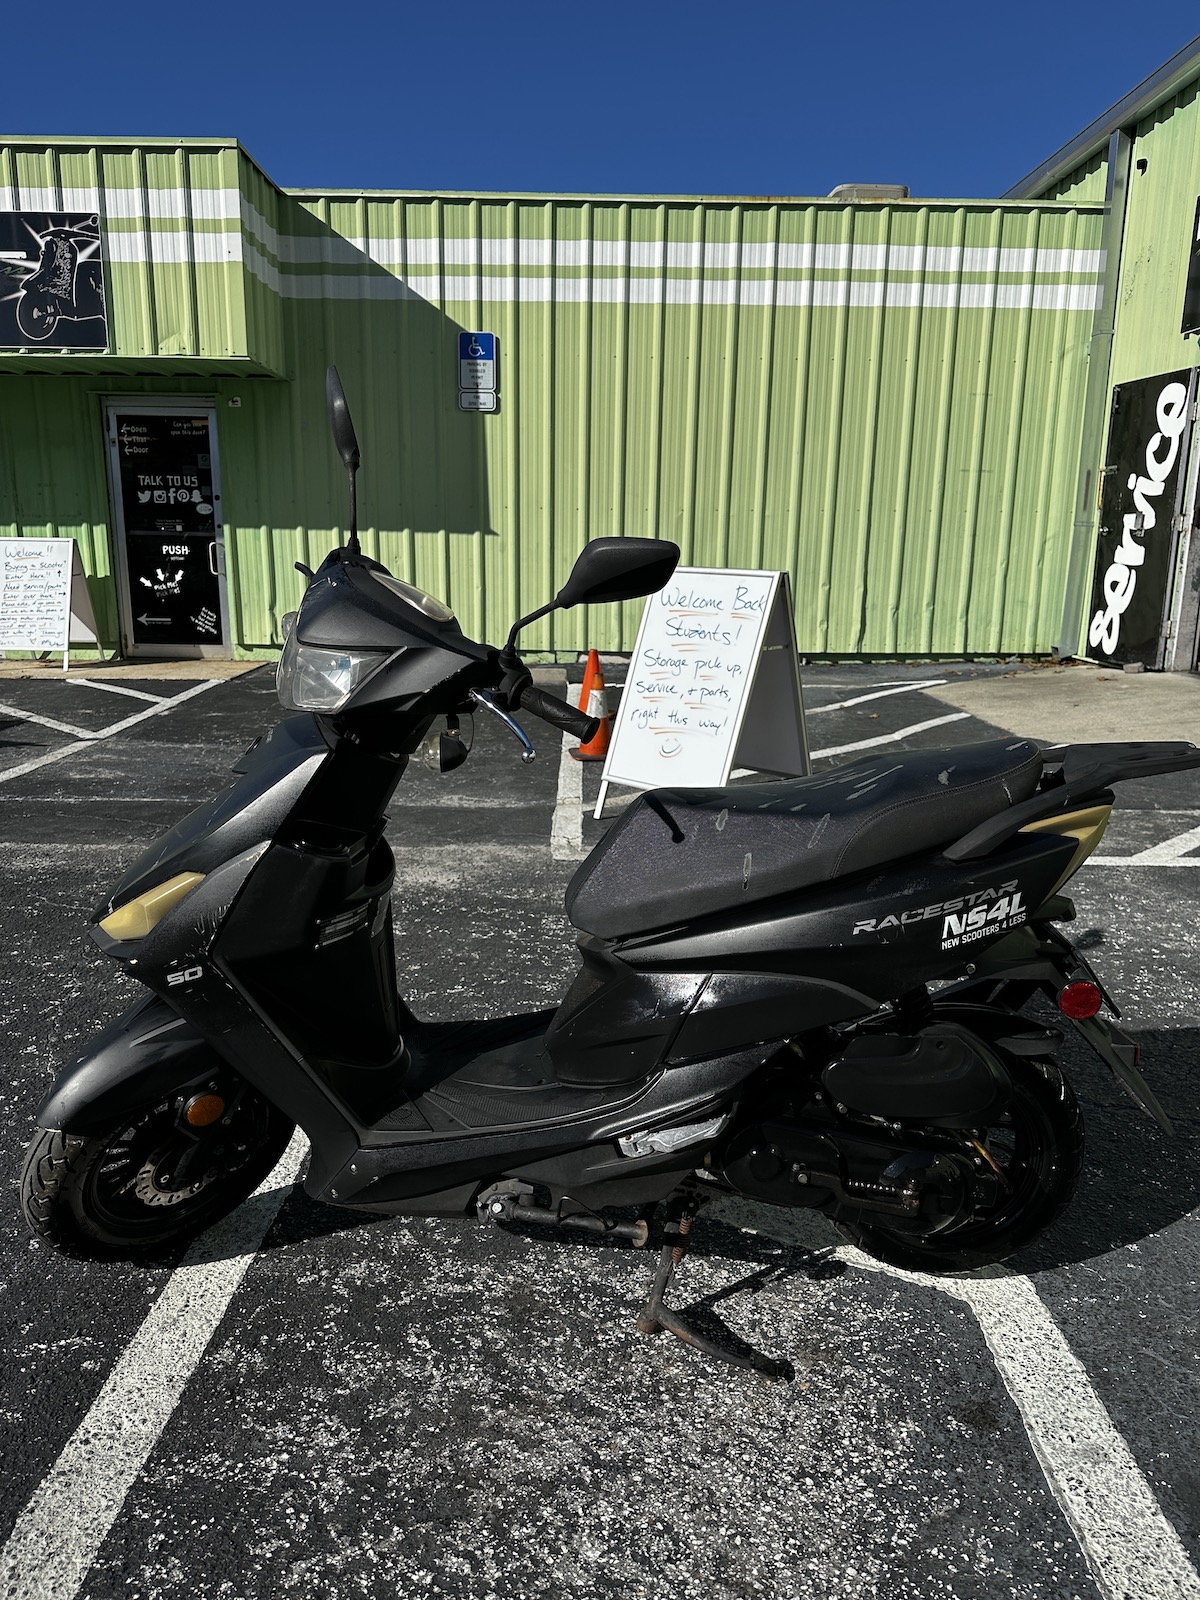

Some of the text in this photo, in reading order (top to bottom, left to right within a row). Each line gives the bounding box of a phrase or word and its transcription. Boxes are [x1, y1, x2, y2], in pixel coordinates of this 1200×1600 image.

[137, 475, 198, 487] TALK TO US
[1089, 382, 1190, 656] service
[162, 545, 189, 555] PUSH
[4, 562, 28, 573] Buying
[660, 585, 767, 614] Welcome Back
[643, 648, 689, 676] Storage
[694, 656, 722, 680] pick
[700, 684, 732, 704] parts,
[630, 707, 729, 736] right this way!
[852, 879, 1019, 936] RACESTAR
[941, 892, 1027, 940] NS4L
[941, 912, 1027, 951] NEW SCOOTERS 4 LESS
[167, 966, 203, 987] 50
